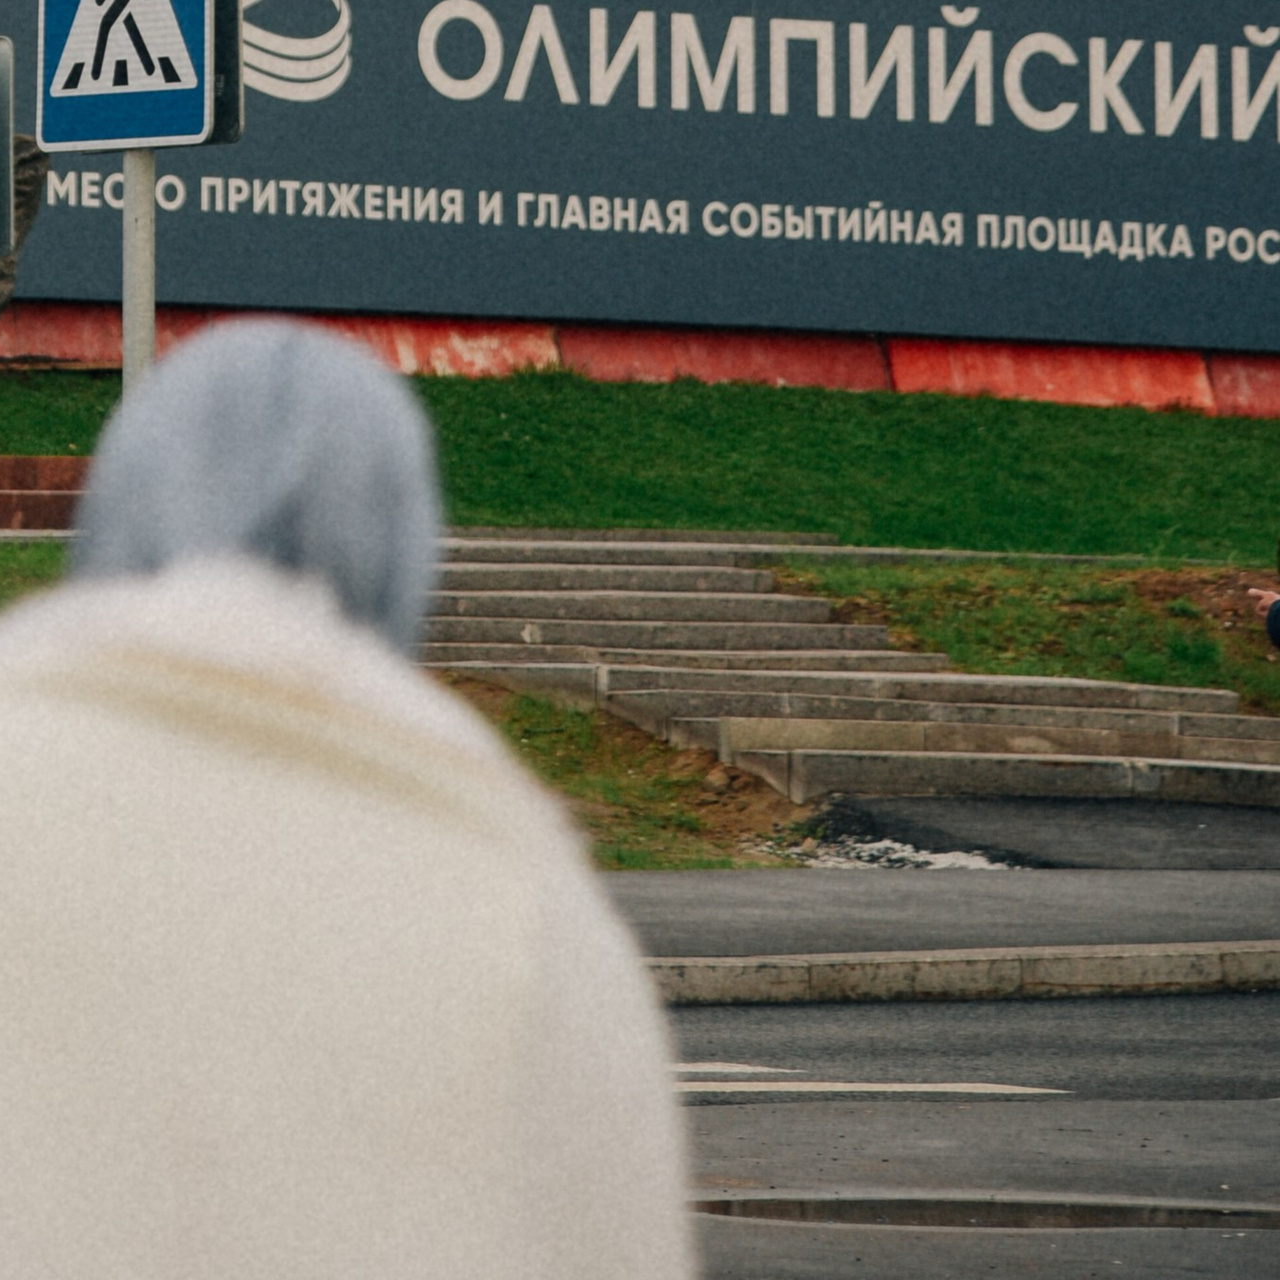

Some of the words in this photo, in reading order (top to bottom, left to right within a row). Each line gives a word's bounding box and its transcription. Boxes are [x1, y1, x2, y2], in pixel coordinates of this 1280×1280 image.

[47, 169, 186, 212] МЕСО
[200, 176, 463, 224] ПРИТЯЖЕНИЯ
[478, 190, 502, 225] И
[517, 192, 689, 234] ГЛАВНАЯ
[702, 200, 963, 246] СОБЫТИЙНАЯ
[977, 214, 1194, 261] ПЛОЩАДКА
